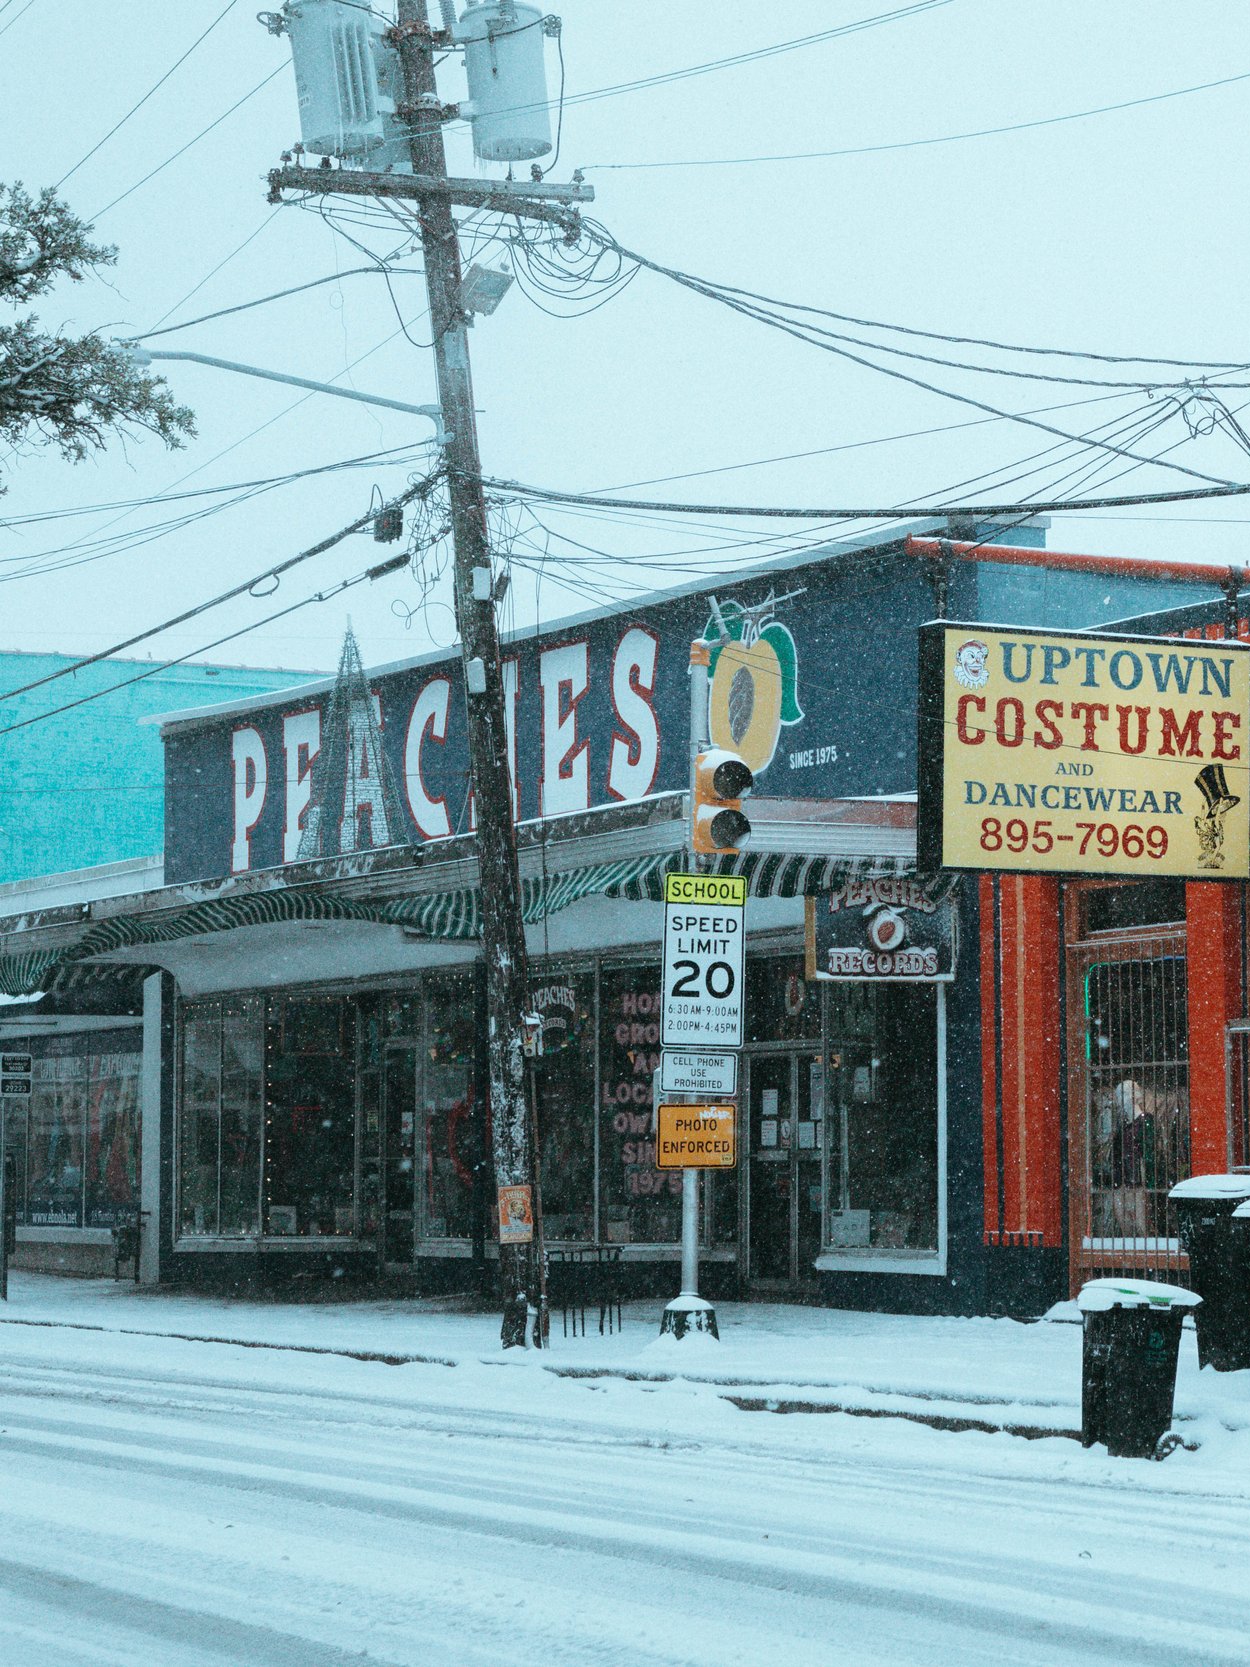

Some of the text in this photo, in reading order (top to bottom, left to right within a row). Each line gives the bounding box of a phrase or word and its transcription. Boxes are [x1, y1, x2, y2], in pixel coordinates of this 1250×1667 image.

[999, 642, 1235, 698] UPTOWN
[955, 694, 1242, 761] COSTUME
[790, 746, 837, 769] SINCE 1975
[1055, 762, 1094, 776] AND
[964, 780, 1184, 815] DANCEWEAR
[980, 818, 1169, 860] 895-7969
[671, 881, 741, 900] SCHOOL
[829, 877, 936, 914] PEACHES
[672, 916, 738, 933] SPEED
[677, 938, 730, 954] LIMIT
[831, 950, 937, 974] RECORDS
[671, 960, 735, 999] 20
[532, 985, 576, 1012] PEACHES
[667, 1020, 737, 1034] 2:00PM-4:45PM
[673, 1057, 725, 1067] CELL PHONE
[690, 1069, 706, 1077] USE
[674, 1079, 723, 1089] PROHIBITED
[675, 1119, 718, 1131] PHOTO
[662, 1141, 730, 1153] ENFORCED
[628, 1172, 682, 1195] 1975
